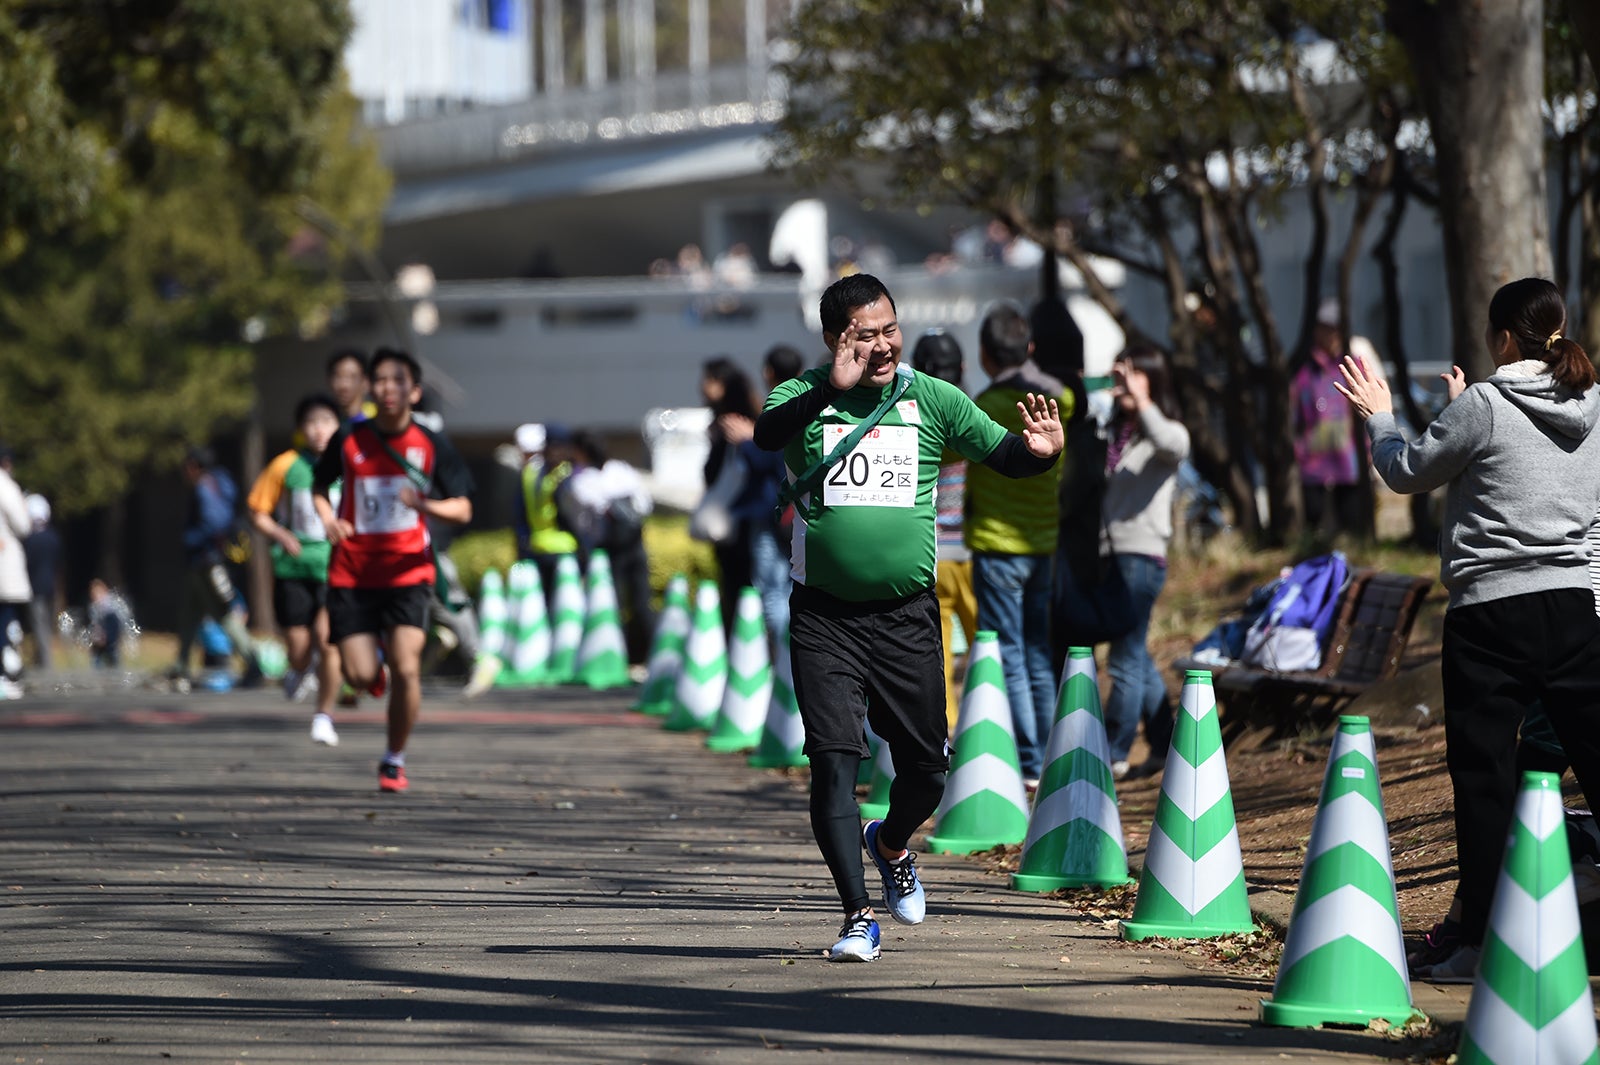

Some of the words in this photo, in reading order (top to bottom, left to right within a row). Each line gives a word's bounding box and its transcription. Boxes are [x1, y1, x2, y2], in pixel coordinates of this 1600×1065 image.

[872, 454, 912, 465] よしもと
[828, 452, 869, 487] 20
[843, 493, 867, 502] チーム
[869, 494, 899, 502] よしもと
